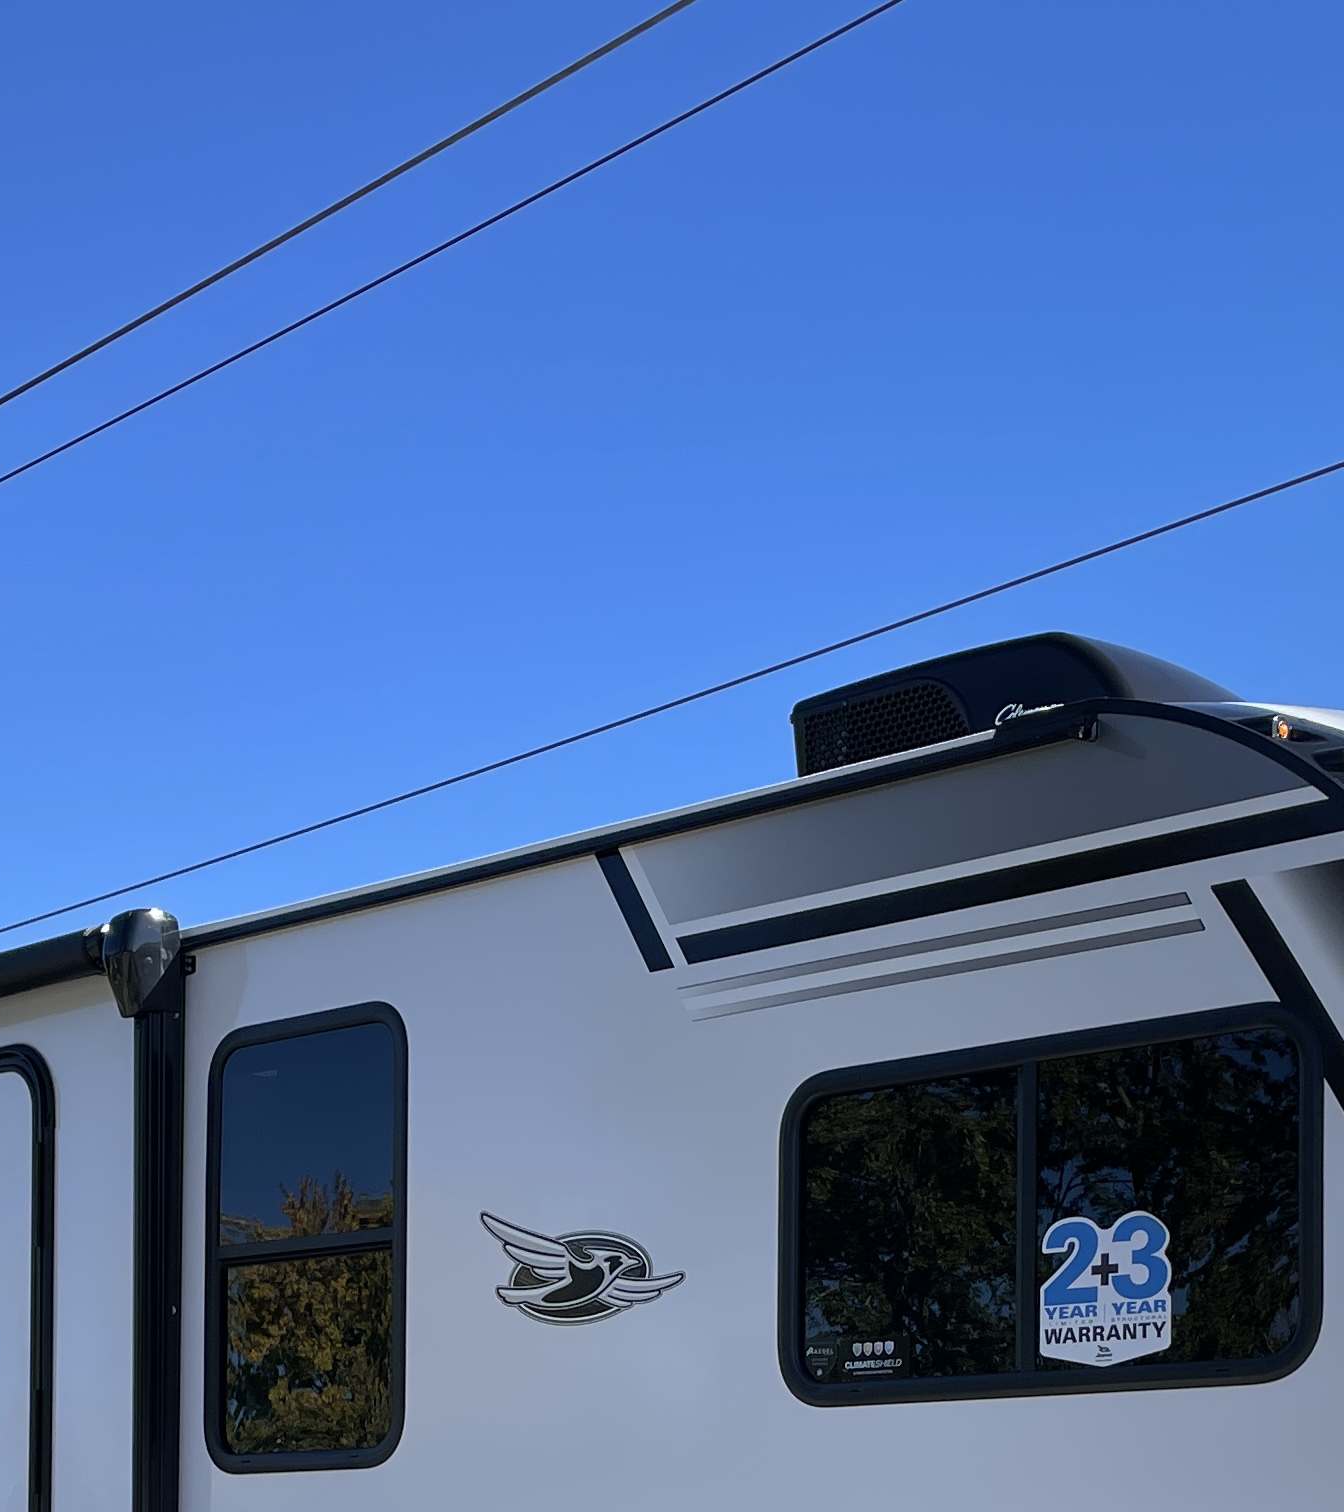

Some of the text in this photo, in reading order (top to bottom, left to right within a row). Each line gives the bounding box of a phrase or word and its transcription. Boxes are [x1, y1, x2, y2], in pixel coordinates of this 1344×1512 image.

[1044, 1299, 1167, 1320] YEAR YEAR
[1044, 1321, 1167, 1345] WARRANTY
